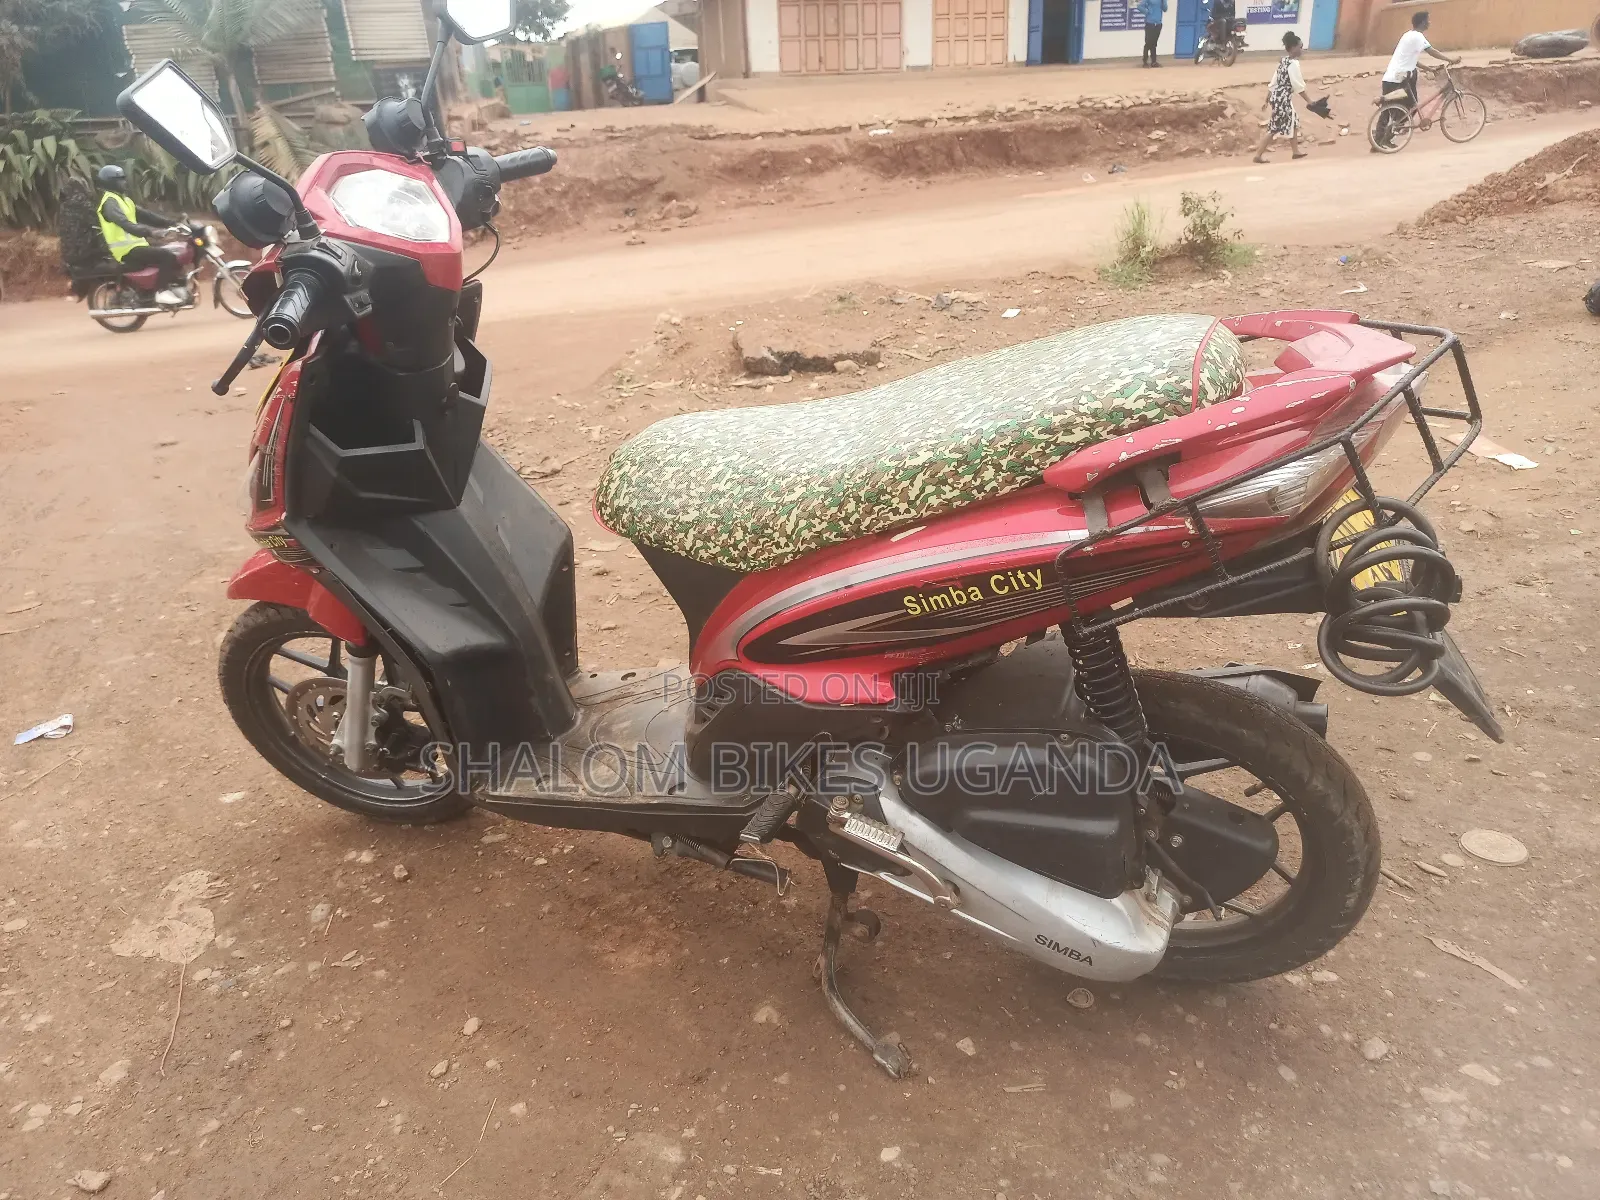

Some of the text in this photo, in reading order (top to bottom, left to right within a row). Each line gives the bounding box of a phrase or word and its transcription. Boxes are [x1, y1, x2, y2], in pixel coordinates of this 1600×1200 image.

[903, 568, 1043, 615] Simba City
[1034, 934, 1093, 967] SIMBA
